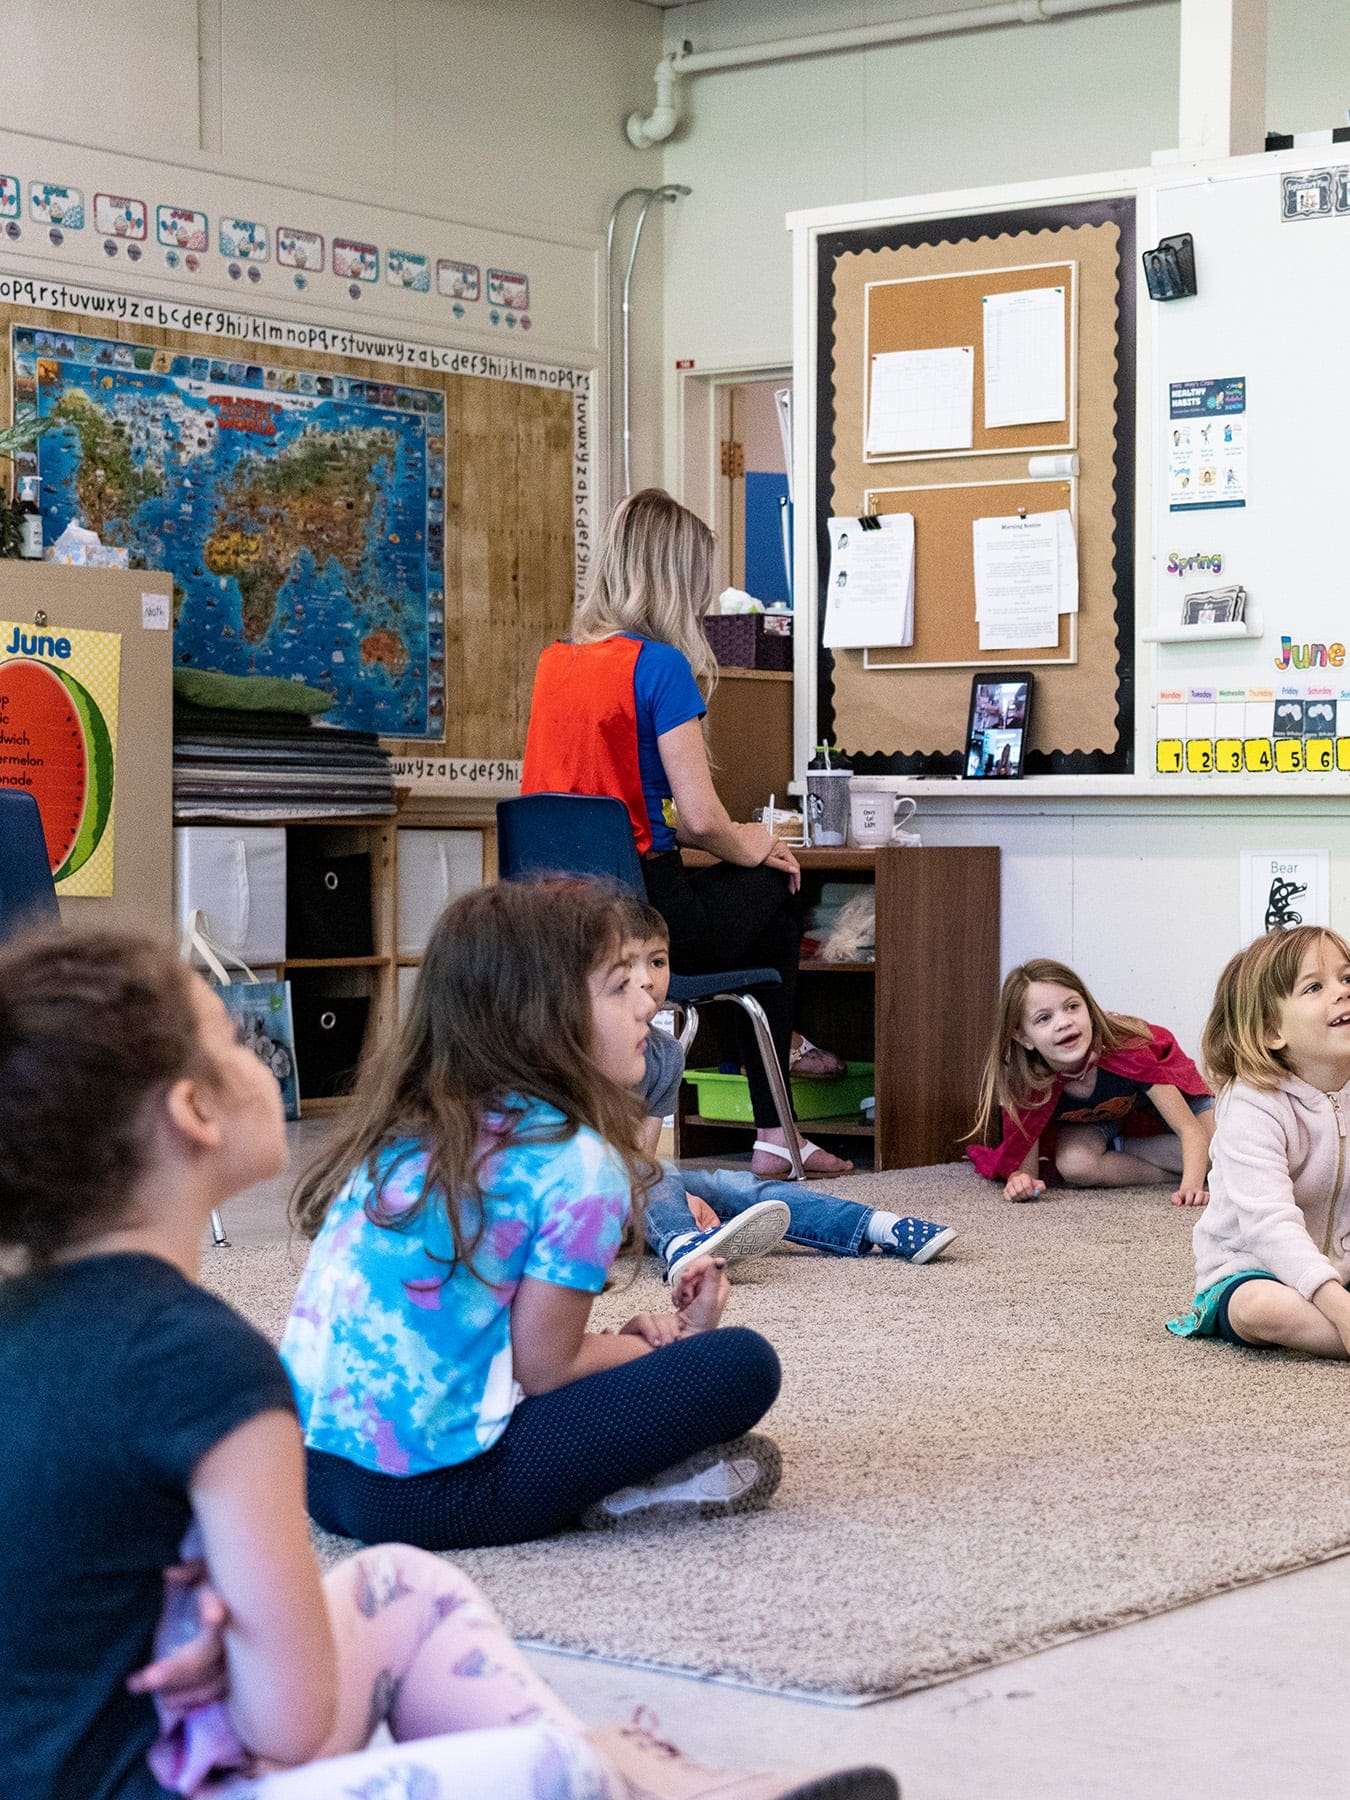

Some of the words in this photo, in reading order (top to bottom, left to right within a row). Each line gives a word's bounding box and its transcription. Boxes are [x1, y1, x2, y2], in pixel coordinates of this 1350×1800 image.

[1172, 387, 1206, 399] HEALTHY
[1172, 397, 1201, 408] HABITS
[1167, 552, 1222, 577] Spring
[6, 627, 72, 659] June
[1274, 635, 1346, 671] June
[1191, 690, 1212, 698] Tuesday
[1281, 687, 1299, 695] Friday
[1173, 752, 1180, 768] 1
[1202, 752, 1210, 768] 2
[1231, 752, 1240, 768] 3
[1259, 751, 1269, 767] 4
[1291, 751, 1300, 768] 5
[1320, 751, 1330, 767] 6
[1270, 860, 1298, 874] Bear
